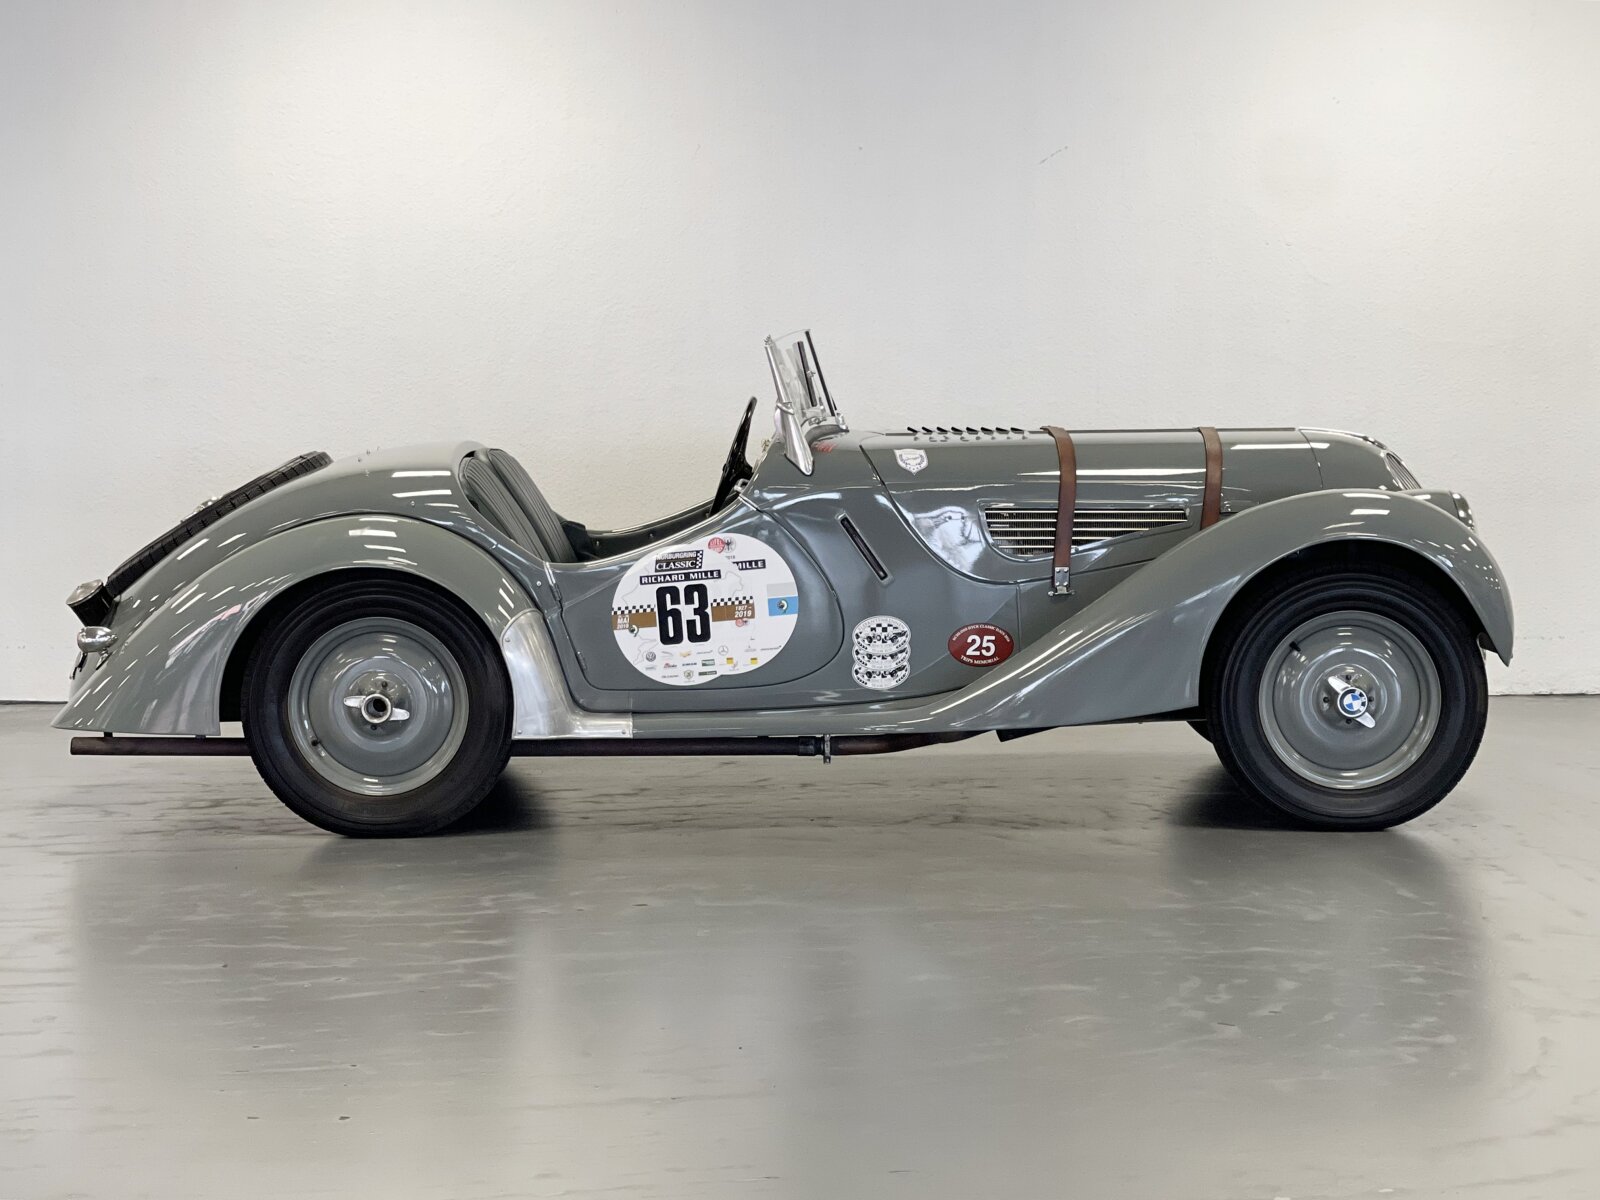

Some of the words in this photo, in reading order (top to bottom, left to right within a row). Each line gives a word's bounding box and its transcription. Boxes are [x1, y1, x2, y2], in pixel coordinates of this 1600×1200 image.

[656, 560, 696, 570] CLASSIC
[641, 573, 686, 584] RICHARD
[689, 570, 719, 580] MILLE
[656, 583, 711, 645] 63
[734, 610, 752, 619] 2019
[966, 634, 996, 657] 25
[960, 655, 974, 664] TRIPS
[974, 656, 1000, 665] MEMORIAL
